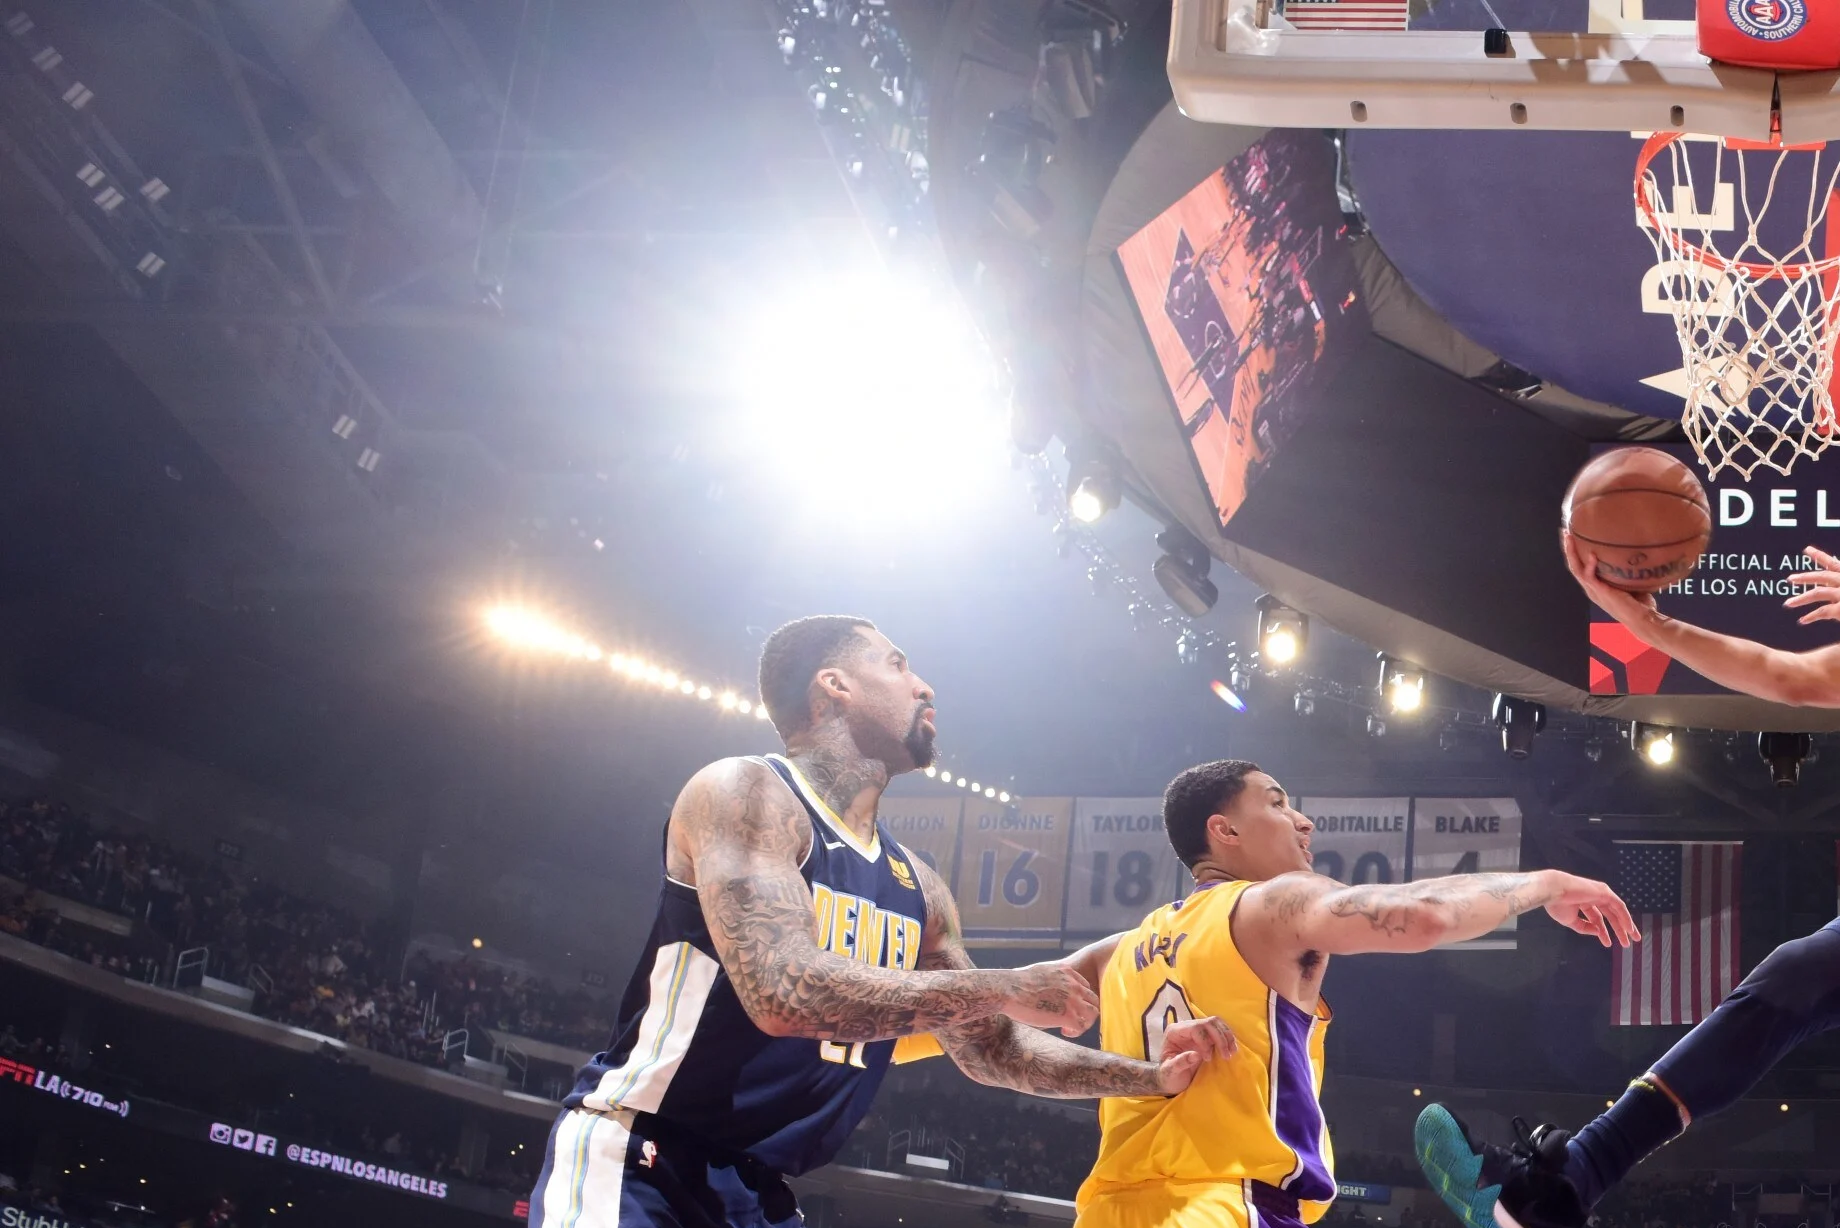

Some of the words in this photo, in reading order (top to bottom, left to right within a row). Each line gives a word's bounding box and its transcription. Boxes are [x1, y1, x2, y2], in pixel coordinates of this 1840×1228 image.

[1763, 13, 1803, 39] SOUTHERN
[1688, 553, 1772, 571] FFICIAL
[1701, 578, 1738, 597] LOS
[1435, 815, 1501, 834] BLAKE
[976, 849, 1041, 909] 16
[1090, 849, 1155, 908] 18
[286, 1143, 448, 1199] @ESPNLOSANGELES
